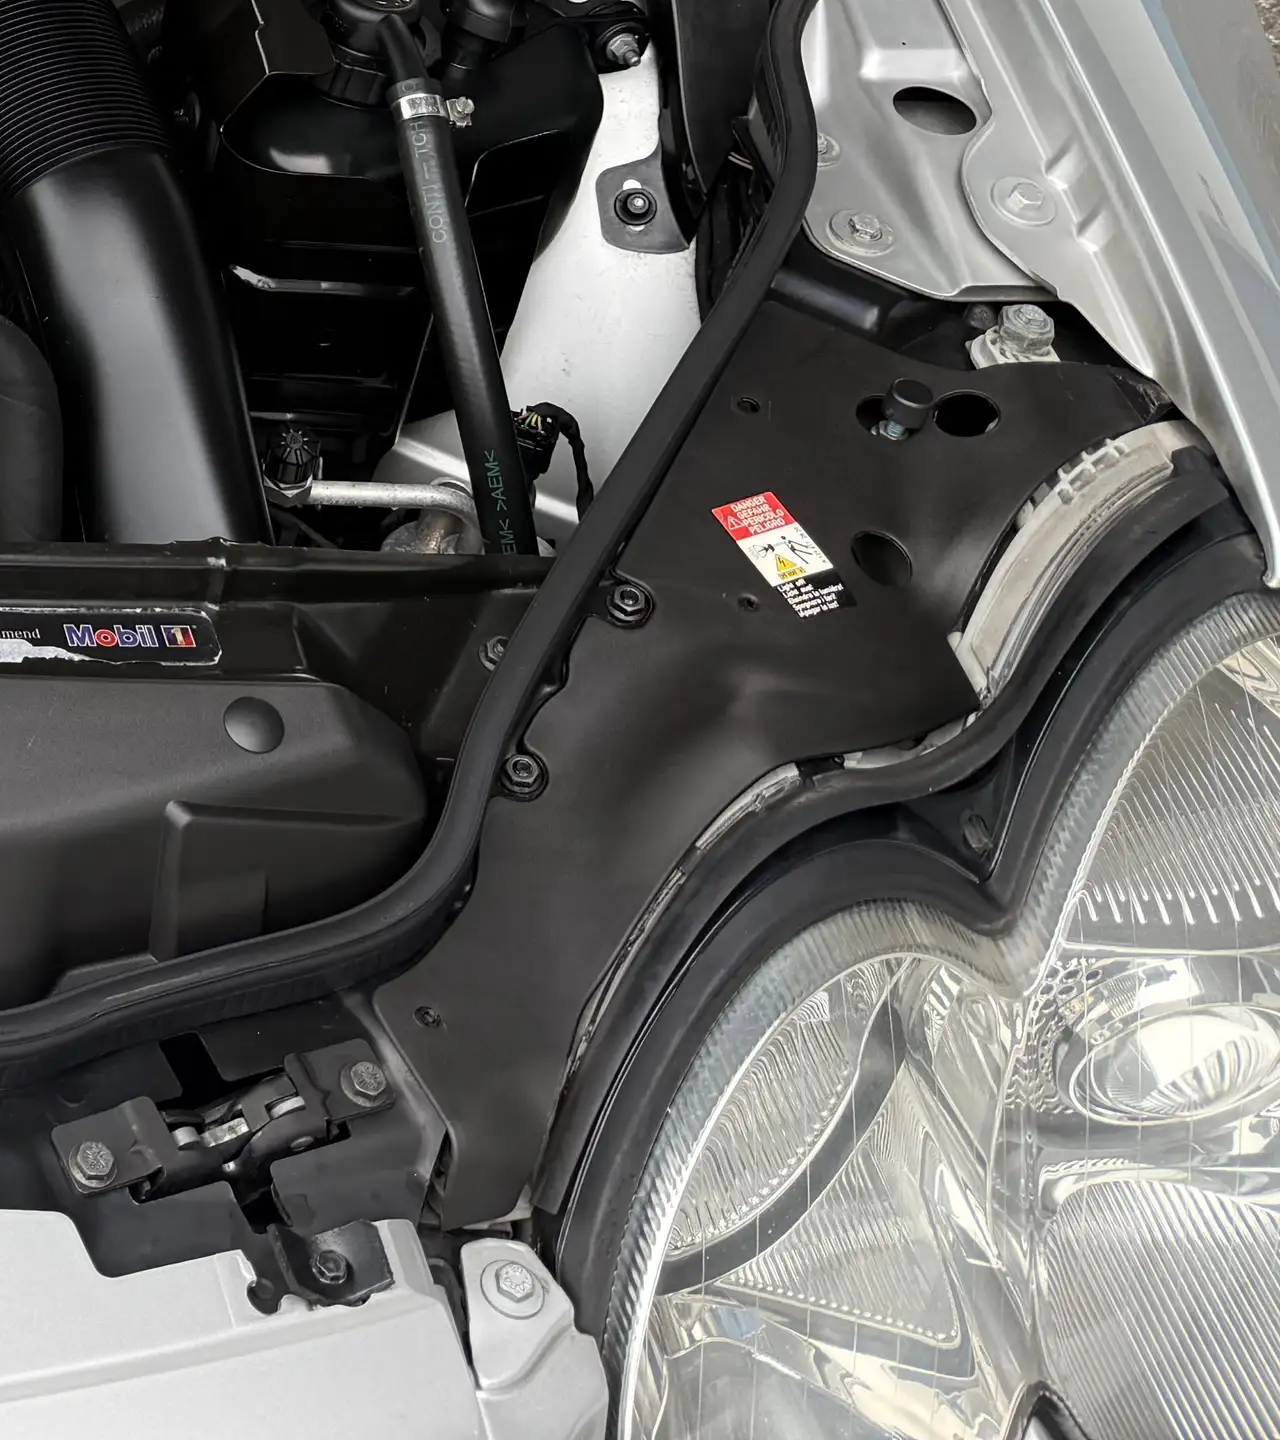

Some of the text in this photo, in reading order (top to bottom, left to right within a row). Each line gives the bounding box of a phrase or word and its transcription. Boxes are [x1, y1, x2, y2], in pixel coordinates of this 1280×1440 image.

[730, 495, 767, 513] DANGER
[736, 504, 772, 520] GEFAHR
[741, 508, 785, 527] PERICOLO
[748, 518, 786, 535] PELIGRO
[63, 624, 160, 648] Mobil
